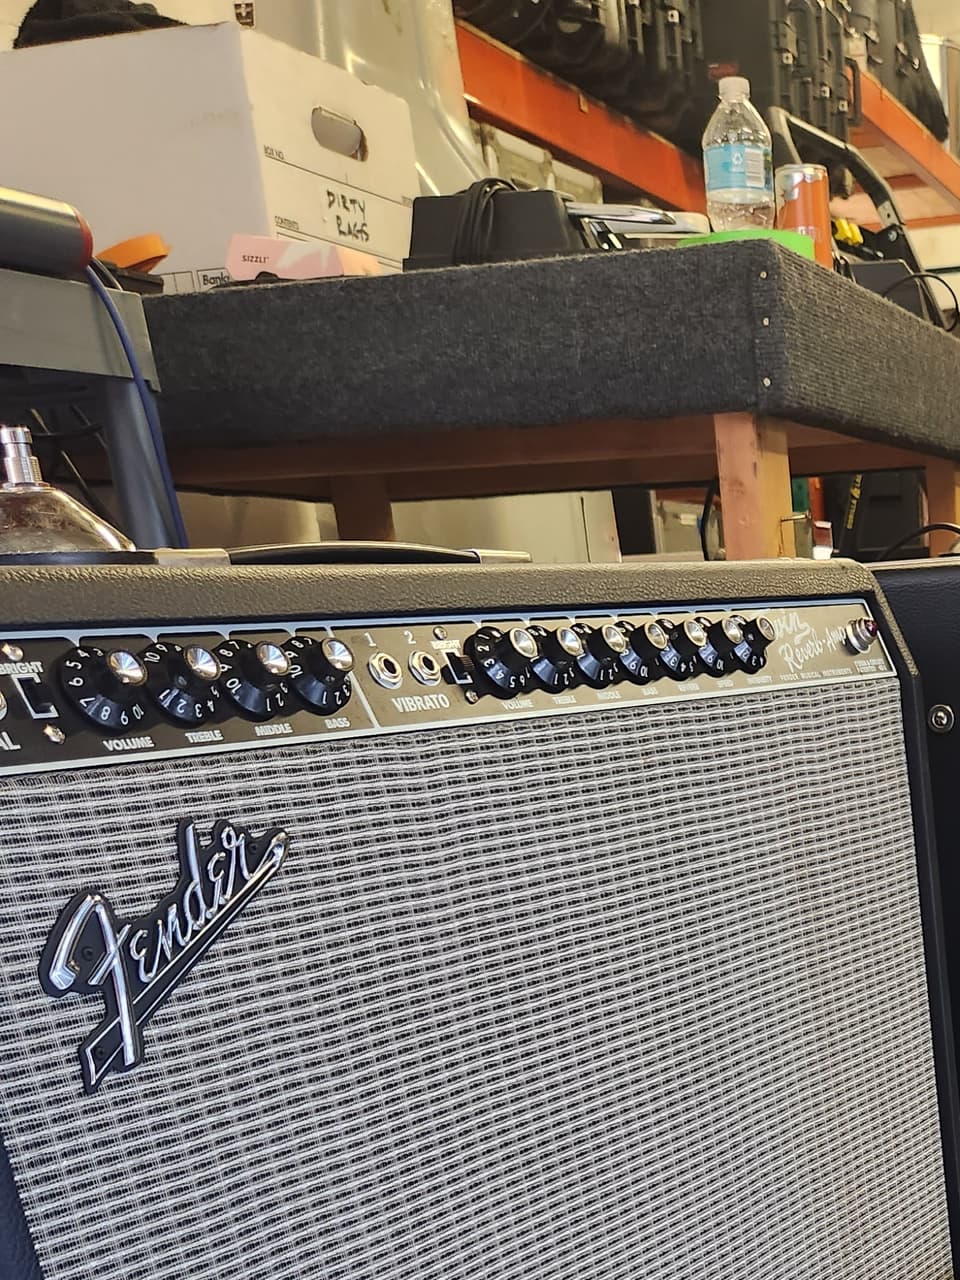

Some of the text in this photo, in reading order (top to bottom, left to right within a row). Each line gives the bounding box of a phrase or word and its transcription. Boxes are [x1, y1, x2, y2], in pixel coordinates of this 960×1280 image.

[326, 189, 366, 222] DIRTY
[391, 693, 450, 713] VIBRATO
[254, 723, 293, 736] MIDDLE
[324, 717, 350, 729] BASS
[185, 730, 224, 743] TREBLE
[103, 737, 155, 751] VOLUME
[40, 819, 290, 1092] Fender
